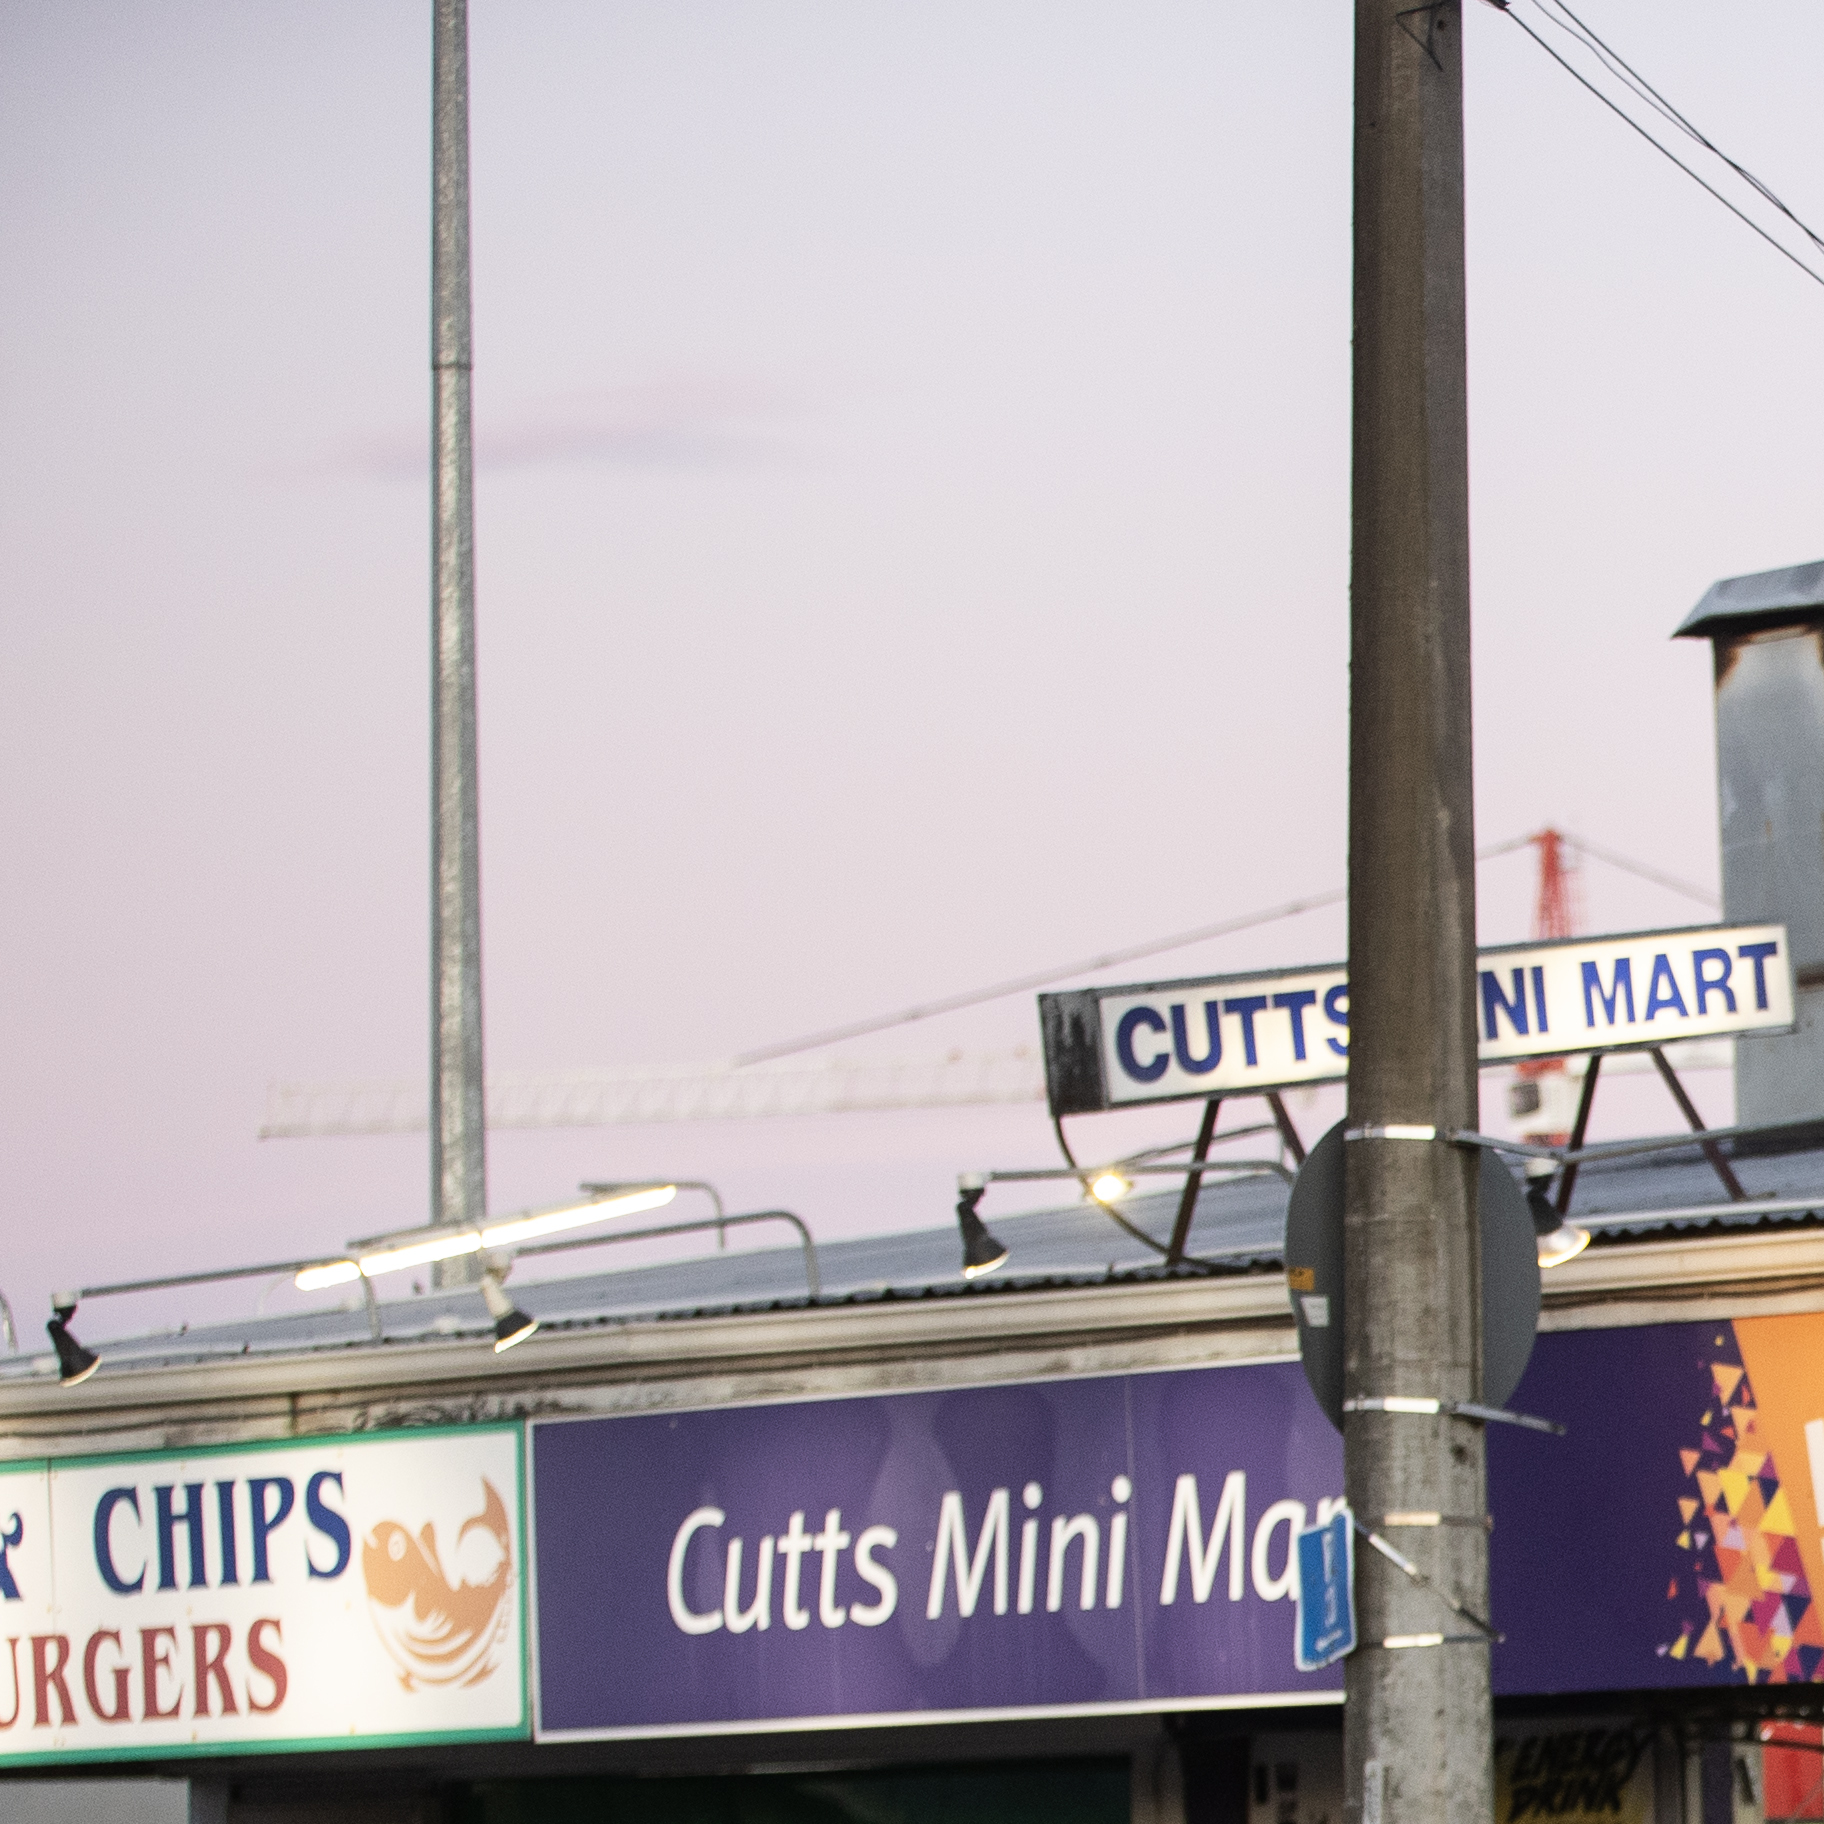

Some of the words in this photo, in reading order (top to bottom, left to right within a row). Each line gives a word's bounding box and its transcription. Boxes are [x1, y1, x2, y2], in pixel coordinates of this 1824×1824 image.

[1114, 983, 1348, 1085] CUTTS
[1479, 965, 1550, 1041] NI
[1580, 940, 1779, 1029] MART
[93, 1469, 352, 1597] CHIPS
[667, 1505, 899, 1636] Cutts
[927, 1474, 1133, 1620] Mini
[1160, 1469, 1346, 1606] Ma
